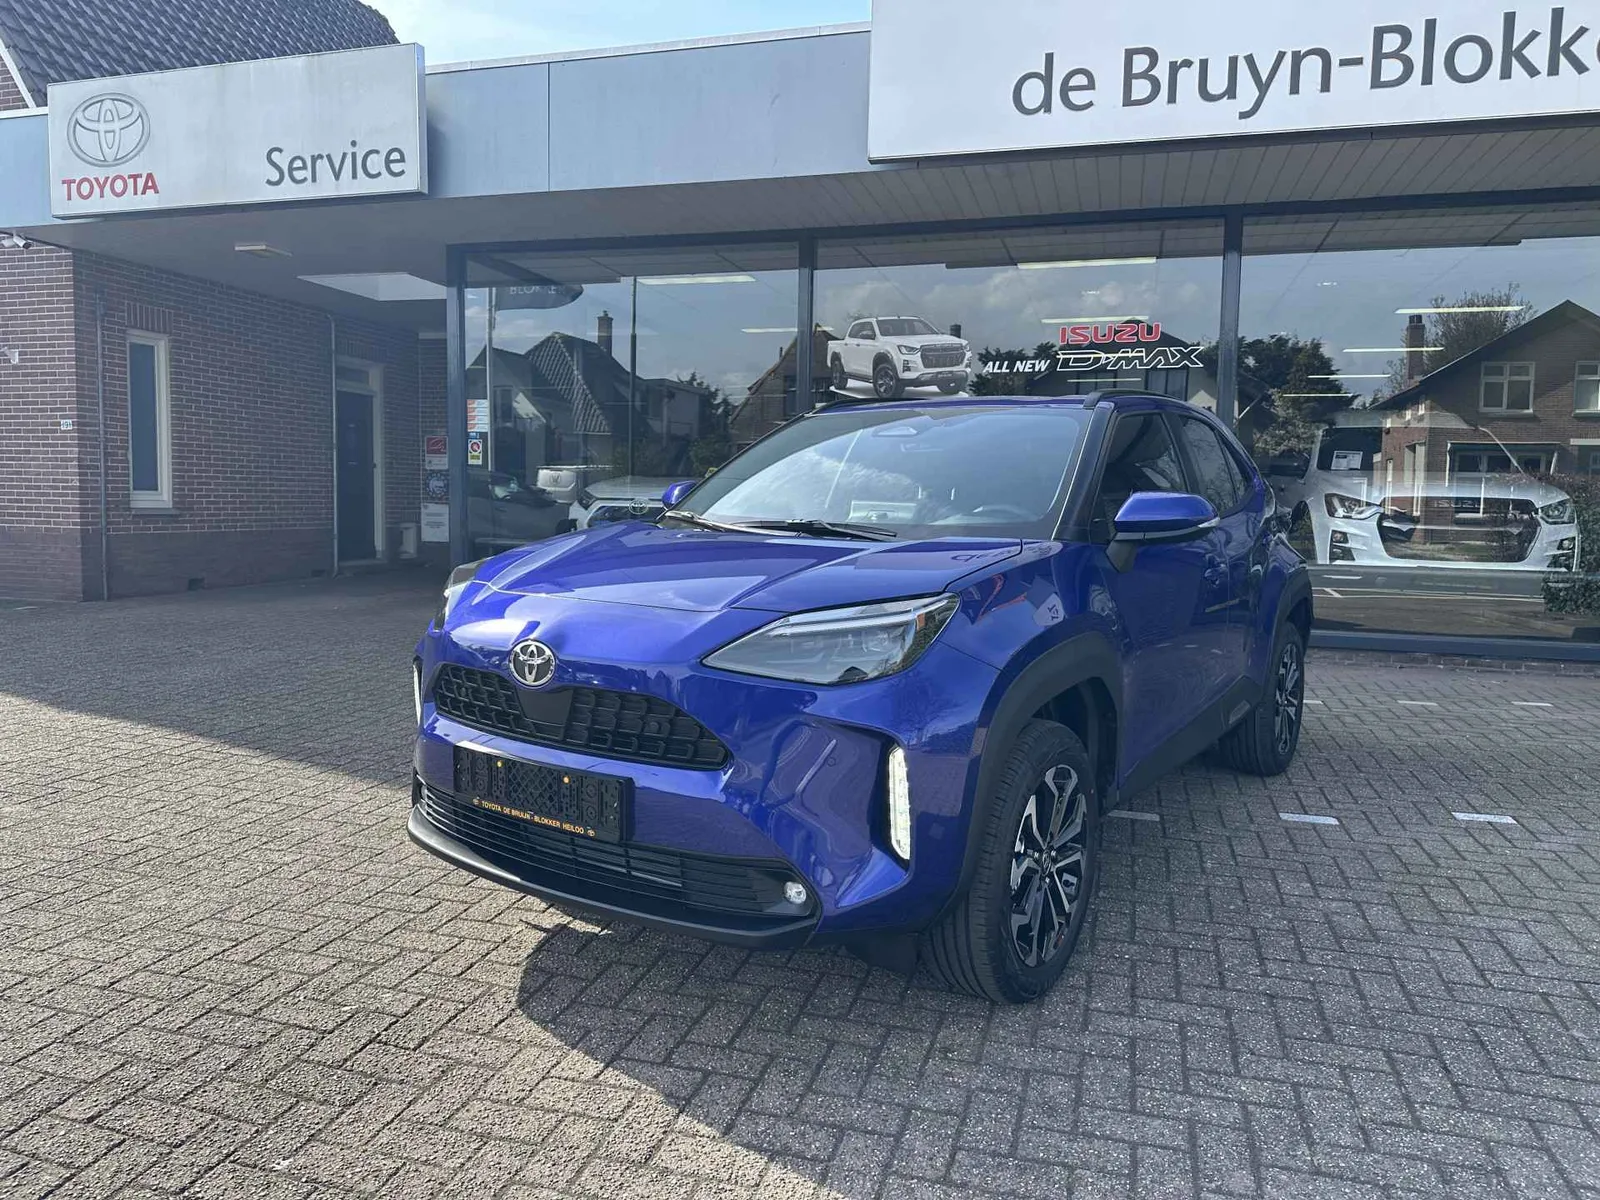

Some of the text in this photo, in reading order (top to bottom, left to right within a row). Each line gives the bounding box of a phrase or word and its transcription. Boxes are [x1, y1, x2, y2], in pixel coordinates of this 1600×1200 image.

[1012, 7, 1600, 120] de Bruyn-Blokk
[265, 140, 406, 187] Service
[61, 172, 160, 201] TOYOTA
[1059, 322, 1161, 345] ISUZU
[982, 360, 1010, 373] ALL
[1013, 360, 1050, 373] NEW
[1434, 499, 1482, 508] ISUZ
[482, 801, 501, 812] TOYOTA
[503, 806, 511, 815] DE
[534, 815, 560, 827] BLOKKER
[562, 822, 584, 834] HEILOO
